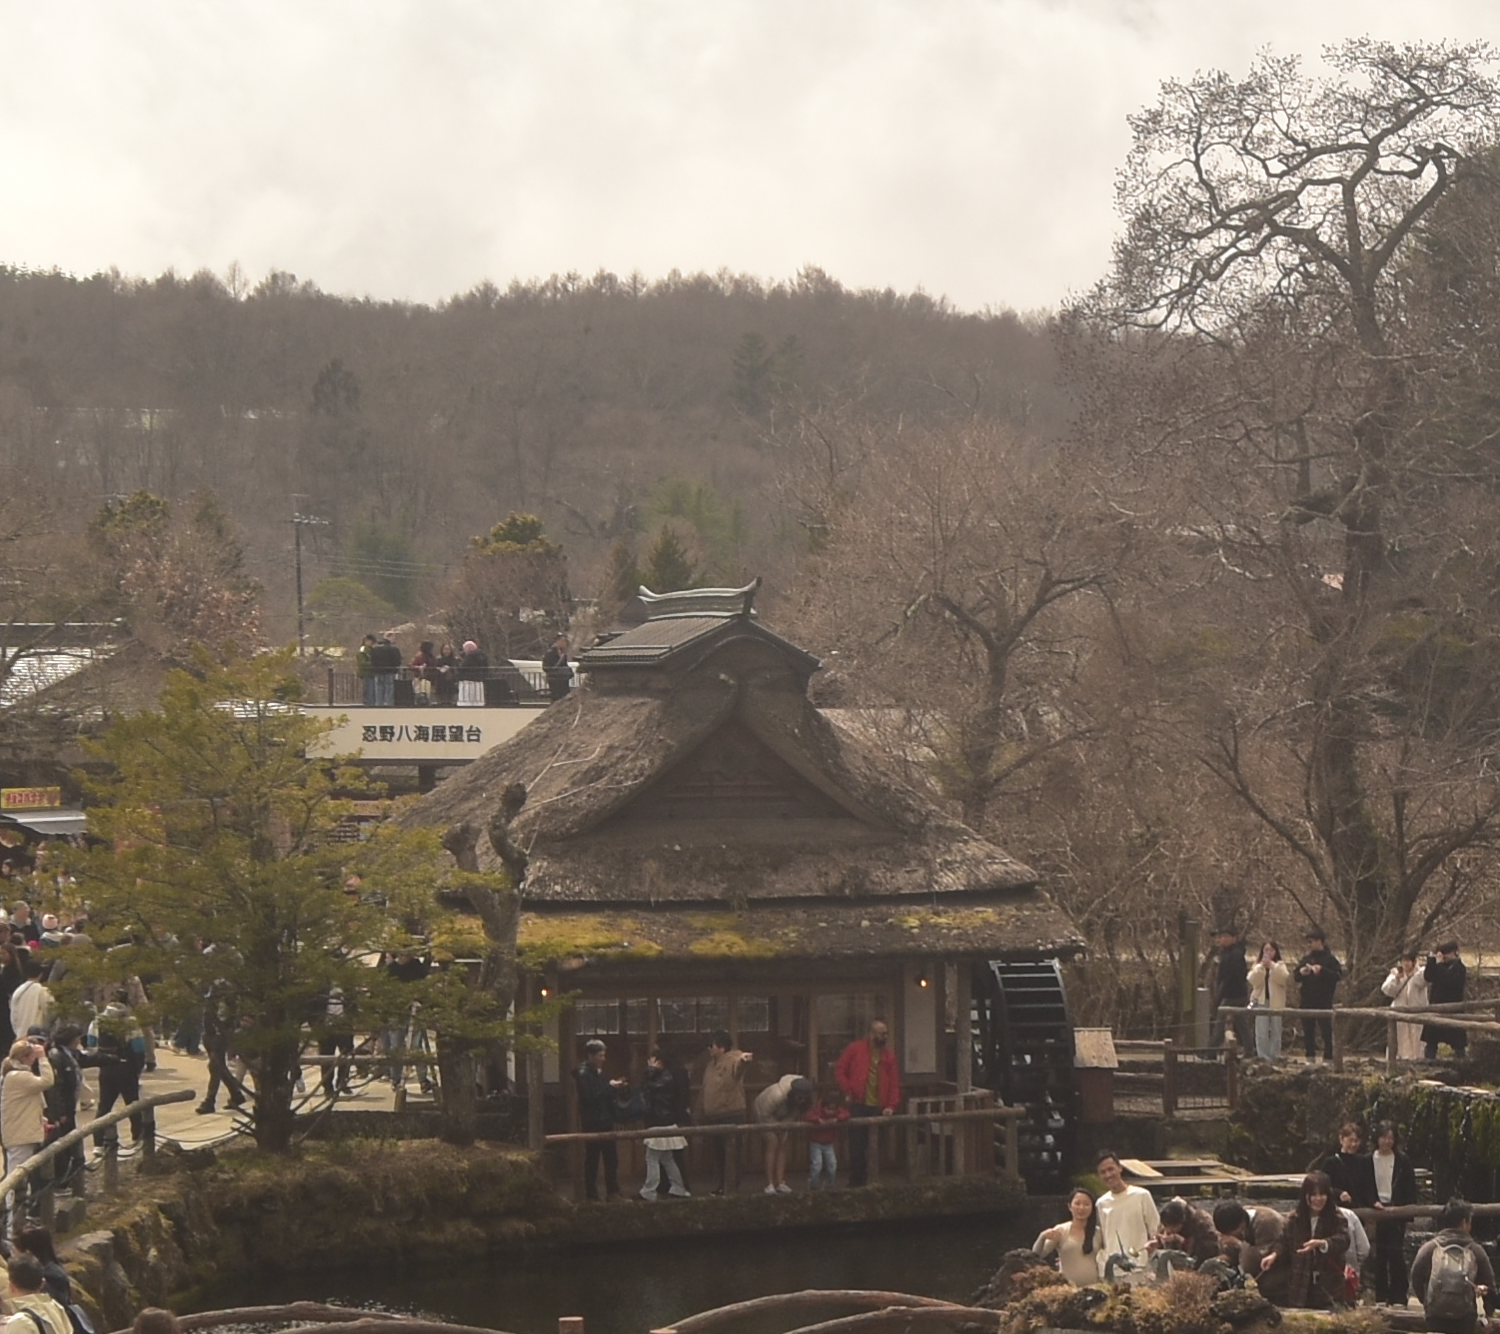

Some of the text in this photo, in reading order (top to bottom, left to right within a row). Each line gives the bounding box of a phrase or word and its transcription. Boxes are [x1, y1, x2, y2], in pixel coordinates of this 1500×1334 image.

[362, 724, 482, 743] 忍野八海展望台
